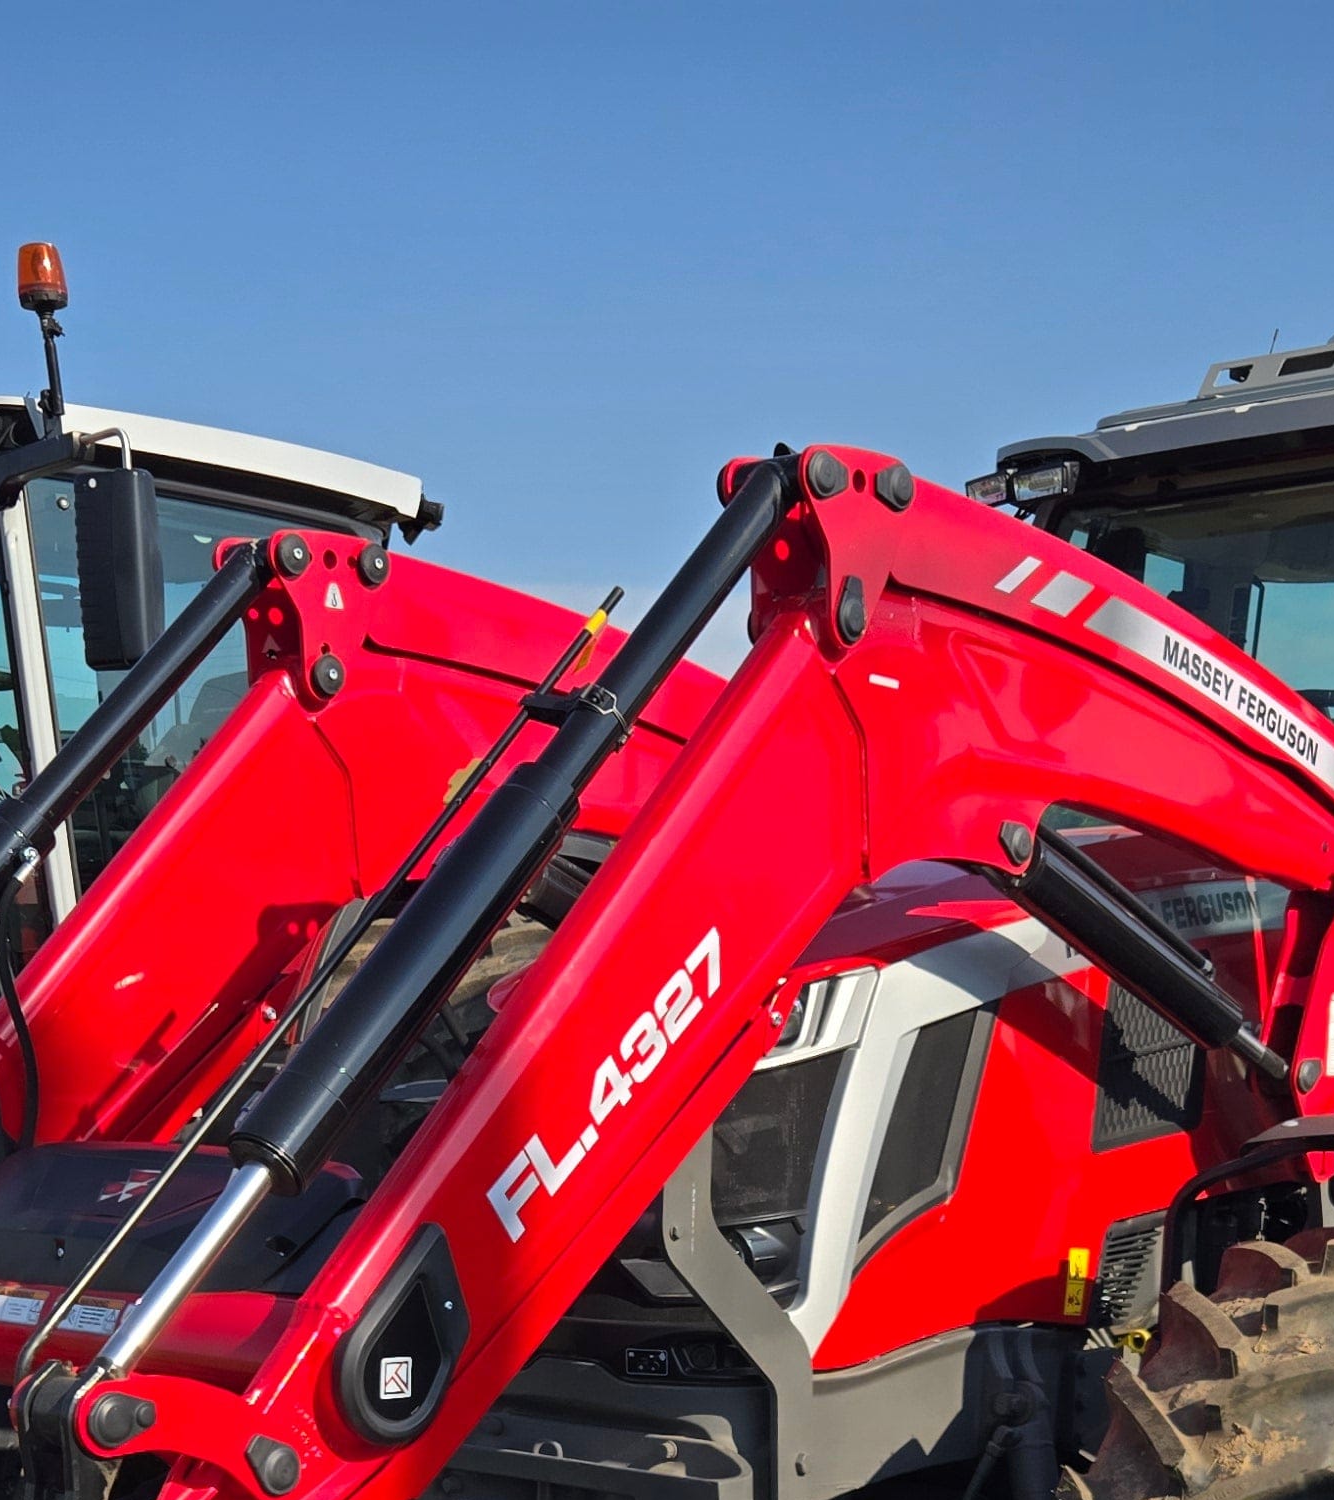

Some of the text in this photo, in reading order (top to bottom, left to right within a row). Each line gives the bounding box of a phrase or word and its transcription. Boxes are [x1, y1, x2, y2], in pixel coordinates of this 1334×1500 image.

[1162, 635, 1319, 766] MASSEY FERGUSON
[1161, 890, 1262, 930] FERGUSON
[485, 926, 721, 1243] FL.4327
